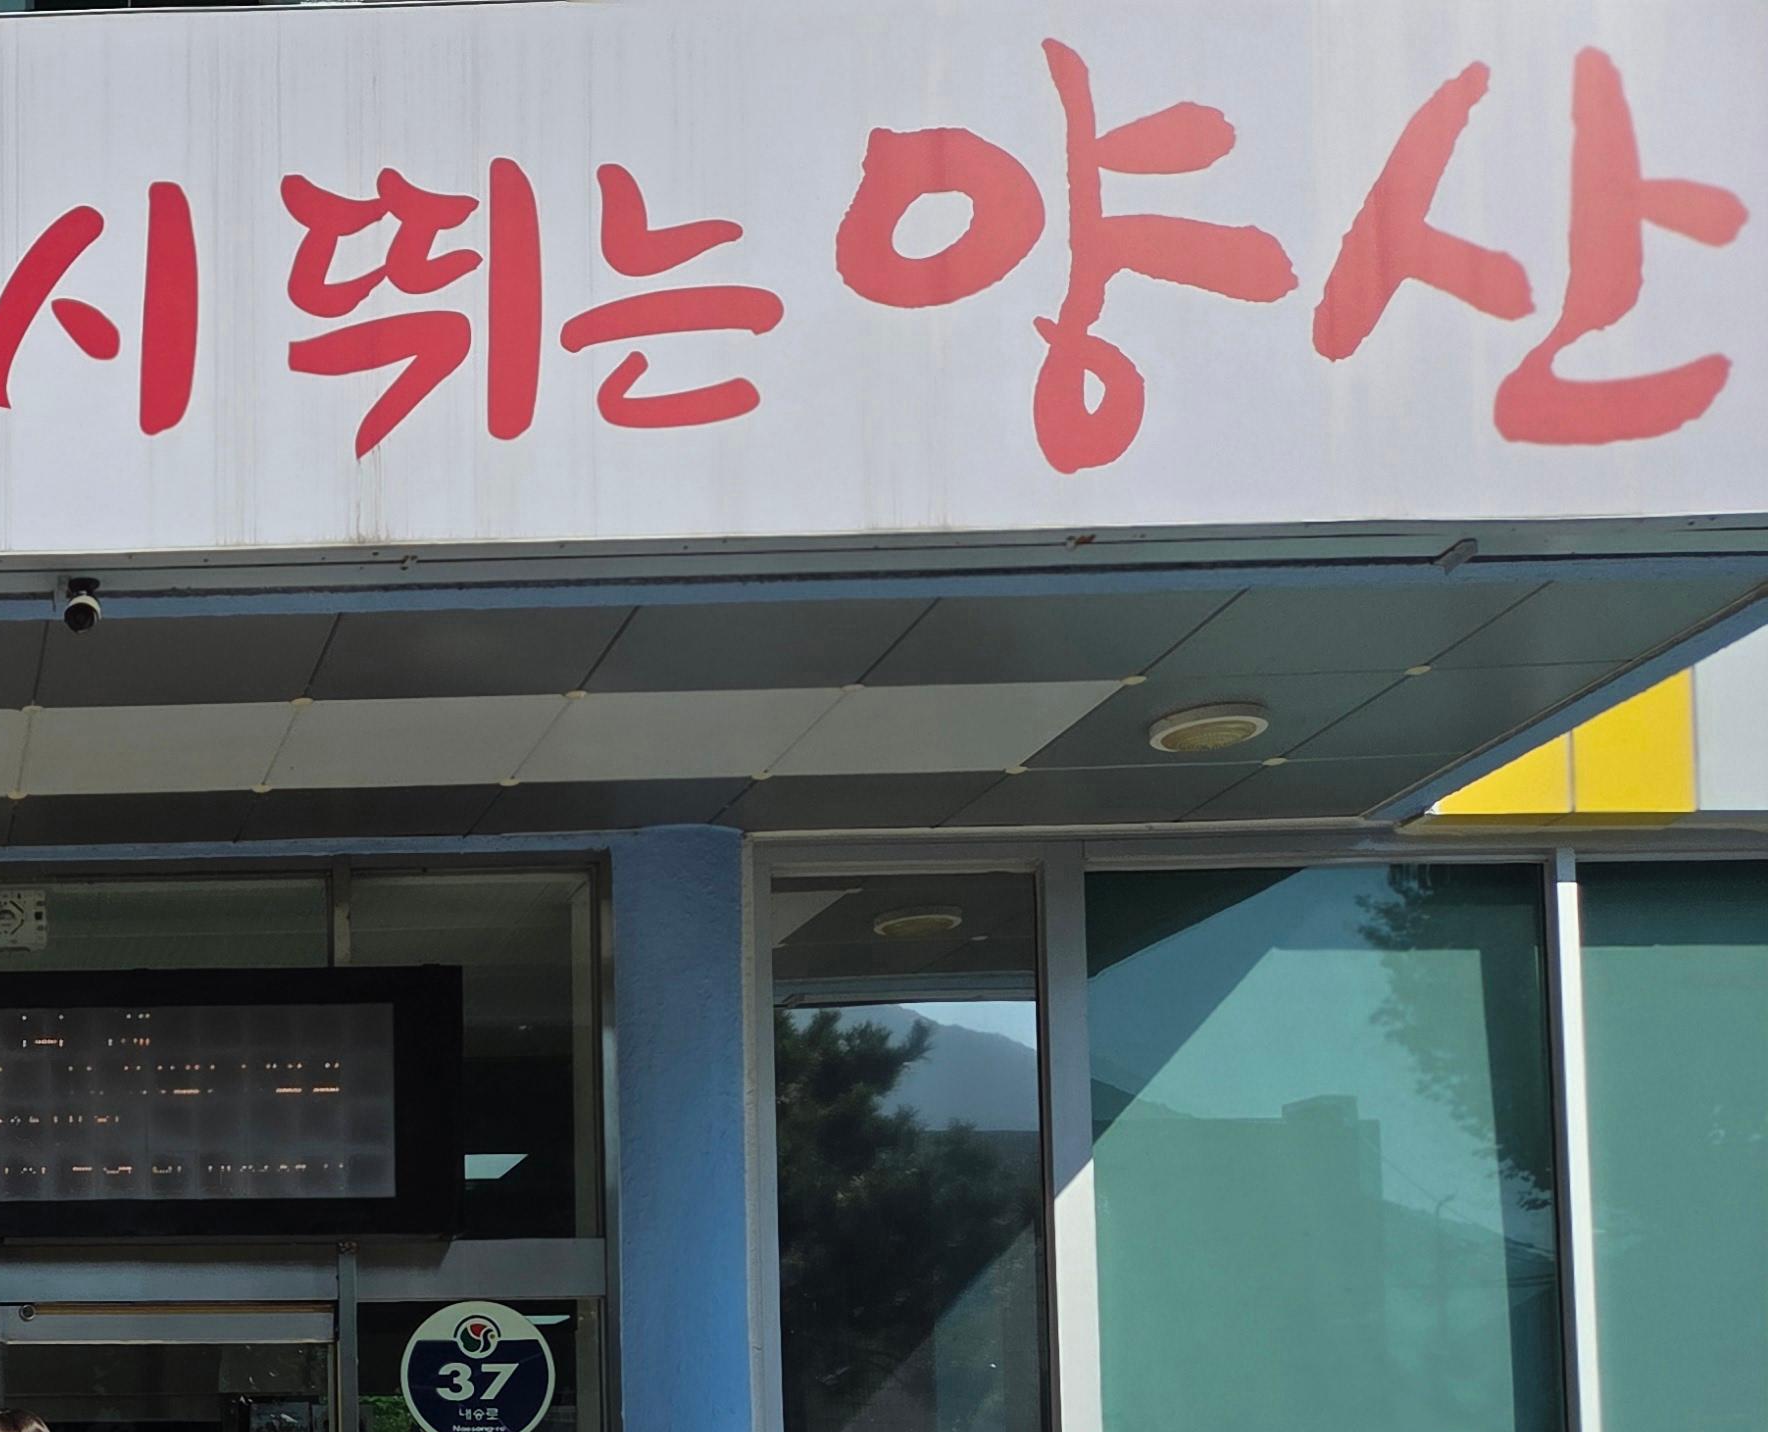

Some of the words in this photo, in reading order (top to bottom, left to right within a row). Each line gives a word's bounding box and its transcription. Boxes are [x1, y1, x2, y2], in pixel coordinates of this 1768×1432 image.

[279, 156, 785, 460] 뛰는
[835, 37, 1749, 475] 양산
[436, 1362, 519, 1401] 37
[459, 1408, 499, 1421] 내송로
